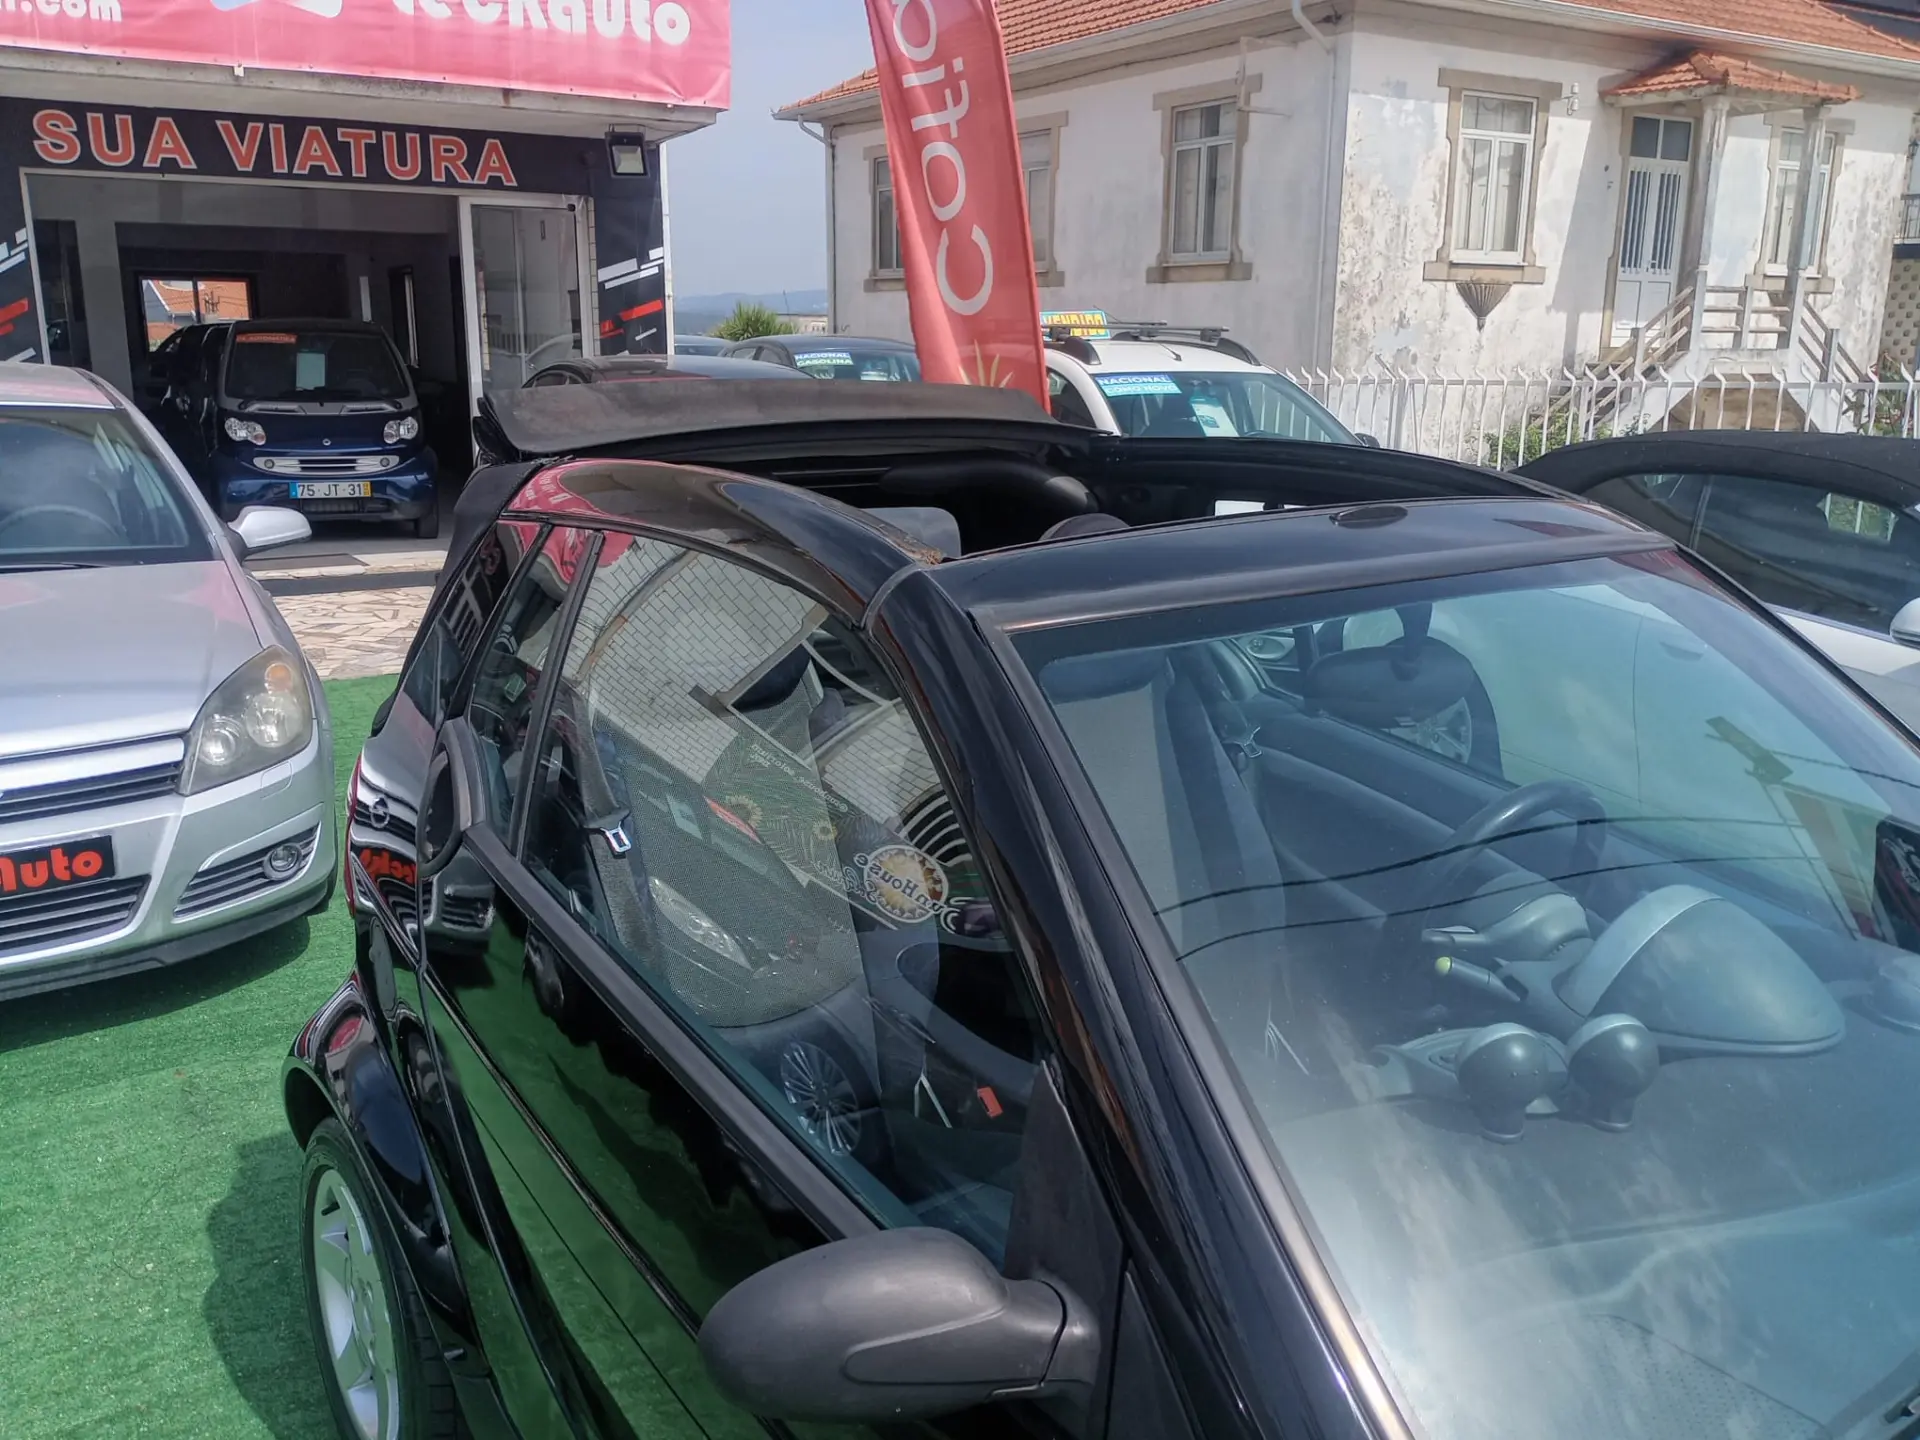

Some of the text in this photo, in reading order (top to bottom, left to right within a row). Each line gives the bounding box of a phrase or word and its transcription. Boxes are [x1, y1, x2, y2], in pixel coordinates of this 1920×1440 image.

[0, 0, 122, 22] .com
[32, 109, 518, 187] SUA VIATURA
[1096, 374, 1173, 386] NACIONAL
